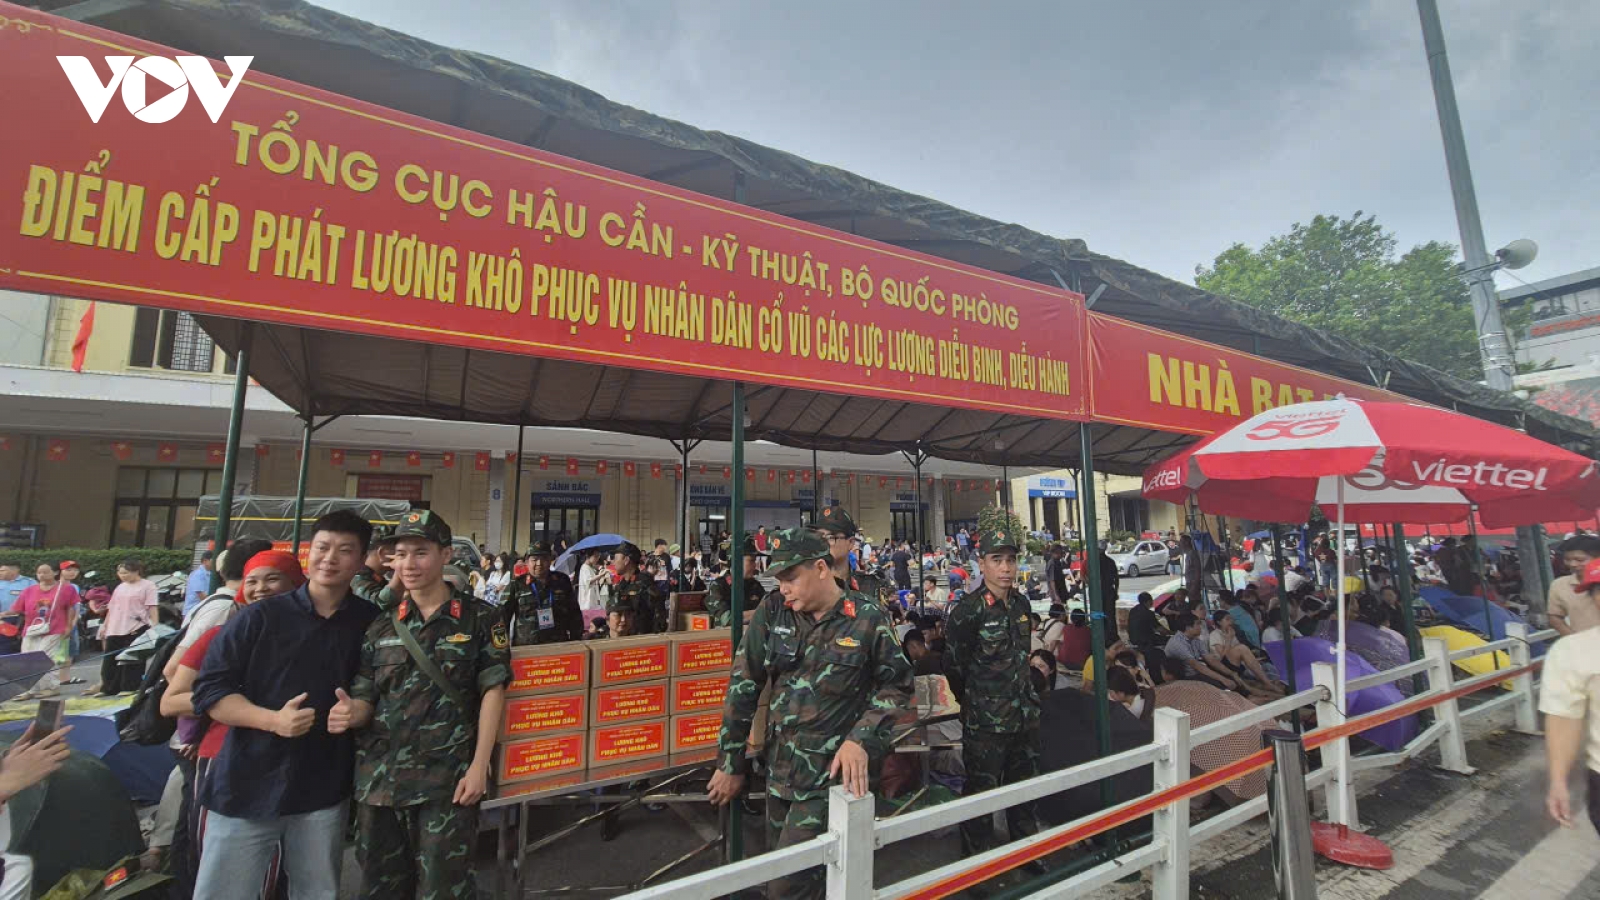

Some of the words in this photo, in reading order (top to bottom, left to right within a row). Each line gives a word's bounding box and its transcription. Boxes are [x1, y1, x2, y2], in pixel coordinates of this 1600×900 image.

[231, 110, 380, 193] TỔNG
[395, 164, 493, 221] CỤC
[507, 187, 587, 243] HẬU
[599, 202, 673, 259] CẦN
[702, 233, 740, 271] KỸ
[747, 246, 832, 297] THUẬT,
[841, 265, 874, 308] BỘ
[881, 275, 947, 315] QUỐC
[951, 293, 1019, 330] PHÒNG
[20, 149, 146, 254] ĐIỂM
[155, 177, 240, 267] CẤP
[248, 208, 346, 285] PHÁT
[352, 229, 458, 305] LƯƠNG
[465, 247, 524, 314] KHÔ
[530, 263, 600, 335] PHỤC
[607, 277, 637, 342] VỤ
[644, 281, 706, 342] NHÂN
[711, 290, 753, 350] DÂN
[758, 291, 784, 353] CỔ
[788, 304, 811, 358] VŨ
[816, 309, 850, 364] CÁC
[854, 322, 884, 376] LỰC
[888, 328, 936, 382] LƯỢNG
[973, 345, 1007, 391] BINH,
[1038, 350, 1070, 396] HÀNH
[1148, 352, 1241, 417] NHÀ
[1245, 416, 1343, 441] 5G
[1411, 458, 1548, 491] viettel
